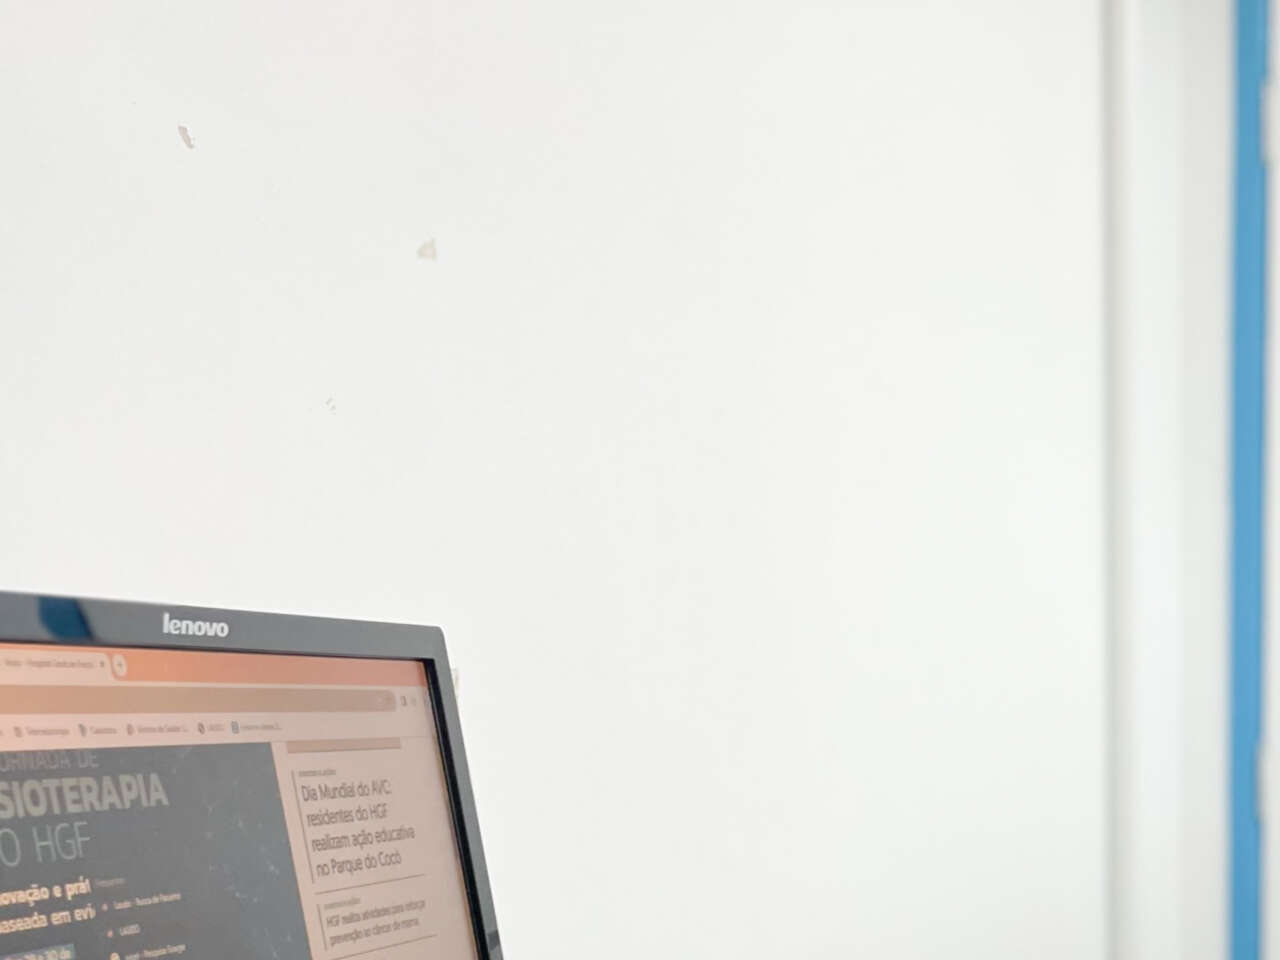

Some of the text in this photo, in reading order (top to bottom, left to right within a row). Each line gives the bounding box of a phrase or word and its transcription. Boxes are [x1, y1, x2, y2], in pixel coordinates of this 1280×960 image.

[163, 612, 229, 637] lenovo
[0, 773, 169, 819] SIOTERAPIA
[301, 785, 318, 802] Dia
[318, 781, 356, 801] Mundial
[356, 780, 370, 797] do
[306, 802, 388, 828] residentes do HGF
[32, 821, 91, 863] HGF
[311, 825, 416, 852] realizam ação educativa
[316, 863, 330, 877] no
[330, 857, 364, 876] Parque
[364, 853, 377, 869] do
[52, 885, 62, 897] e
[50, 910, 72, 926] em
